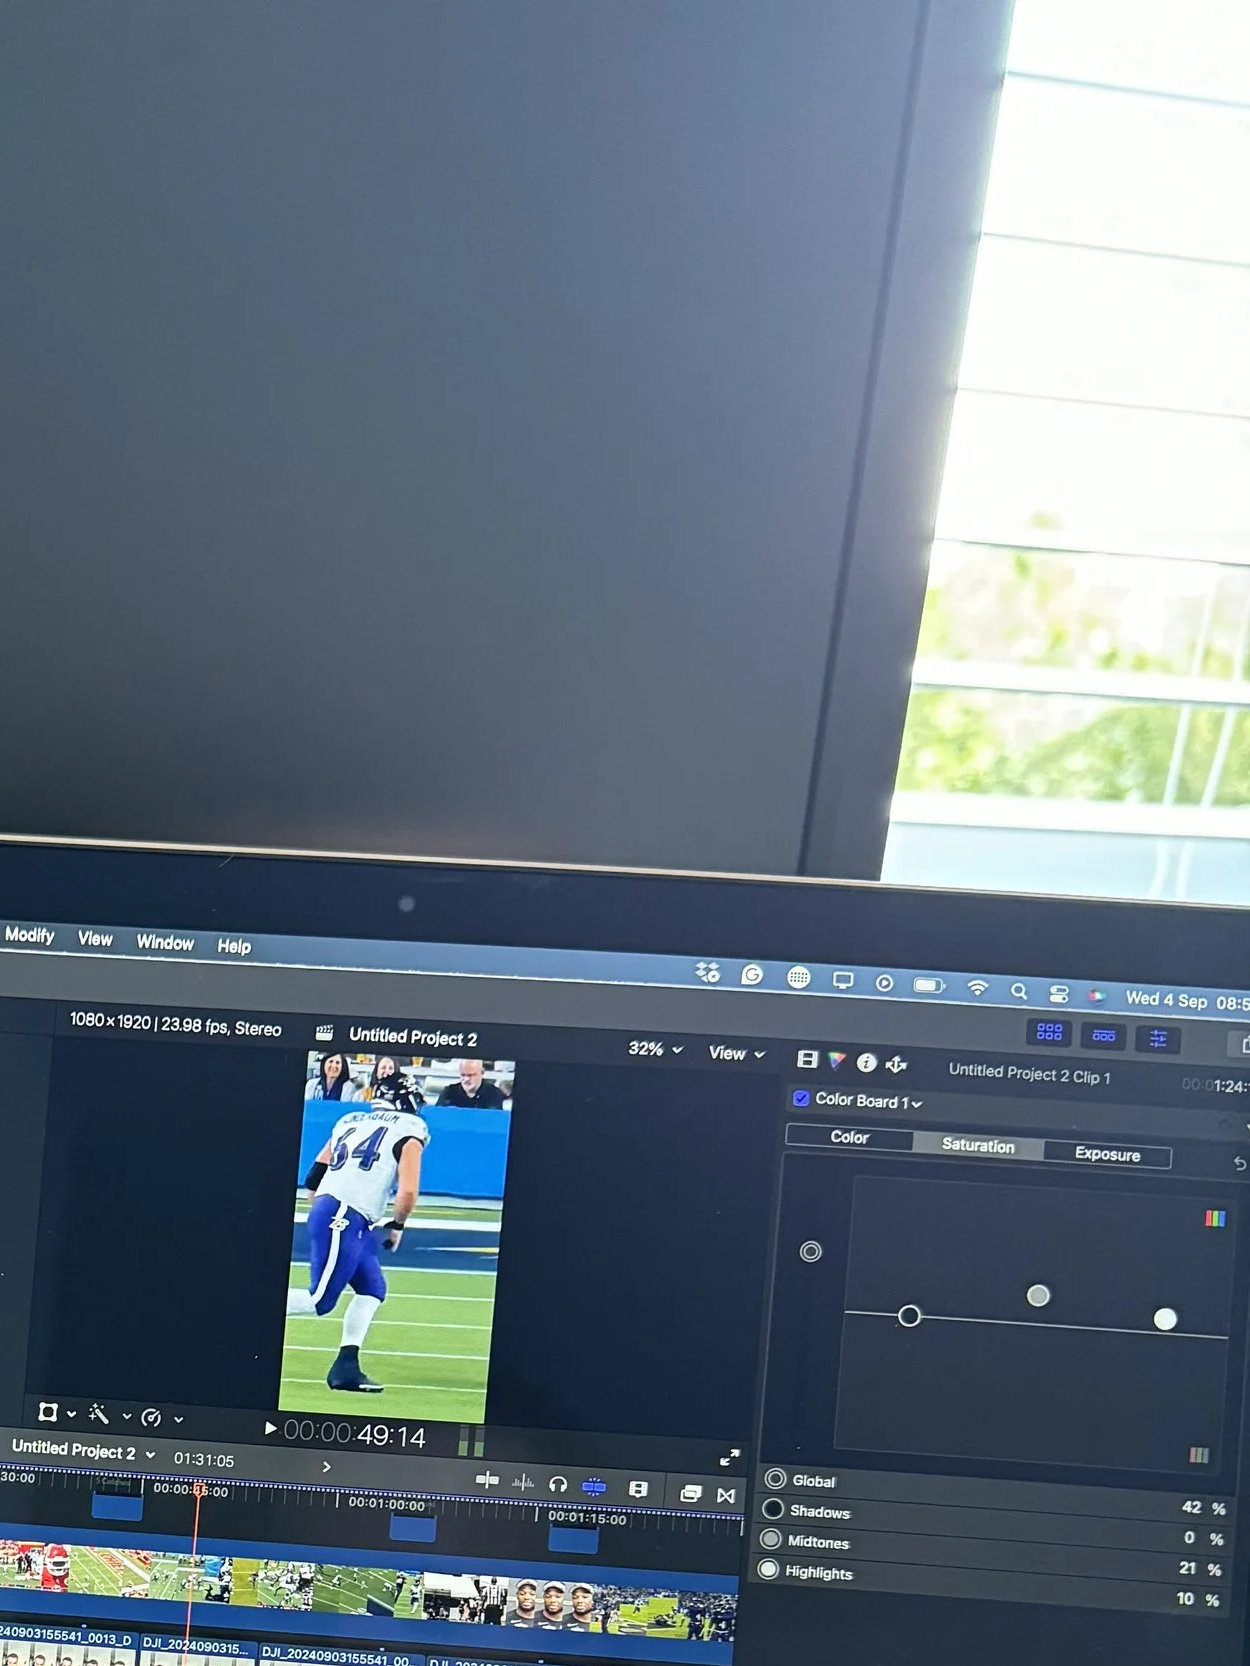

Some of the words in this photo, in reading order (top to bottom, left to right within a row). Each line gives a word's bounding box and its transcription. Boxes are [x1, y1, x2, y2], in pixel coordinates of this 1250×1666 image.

[5, 926, 55, 946] Modify
[78, 930, 113, 947] View
[137, 934, 195, 951] Window
[218, 938, 251, 956] Help
[1126, 990, 1159, 1005] Wed
[1163, 993, 1174, 1007] 4
[1178, 994, 1208, 1011] Sep
[161, 1016, 202, 1034] 23.98
[205, 1018, 231, 1037] fps,
[235, 1020, 282, 1038] Stereo
[349, 1026, 407, 1044] Untitled
[410, 1030, 464, 1048] Project
[467, 1032, 478, 1047] 2
[628, 1040, 664, 1057] 32%
[709, 1045, 746, 1062] View
[949, 1062, 1004, 1080] Untitled
[1008, 1065, 1057, 1083] Project
[1061, 1069, 1070, 1082] 2
[1073, 1069, 1100, 1085] Clip
[1104, 1071, 1111, 1084] 1
[815, 1092, 853, 1107] Color
[856, 1094, 898, 1110] Board
[901, 1096, 908, 1110] 1
[830, 1130, 869, 1145] Color
[942, 1137, 1015, 1155] Saturation
[1075, 1146, 1141, 1164] Exposure
[284, 1419, 426, 1449] 00:00:49:14
[12, 1439, 68, 1457] Untitled
[71, 1442, 124, 1461] Project
[126, 1447, 136, 1460] 2
[174, 1451, 234, 1468] 01:31:05
[792, 1474, 836, 1489] Global
[348, 1496, 425, 1512] 00:01:00:00
[548, 1510, 627, 1526] 00:01:15:00
[790, 1504, 851, 1521] Shadows
[1182, 1501, 1202, 1515] 42
[788, 1534, 850, 1551] Midtones
[785, 1564, 853, 1582] Highlights
[1179, 1561, 1196, 1575] 21
[1177, 1592, 1194, 1606] 10
